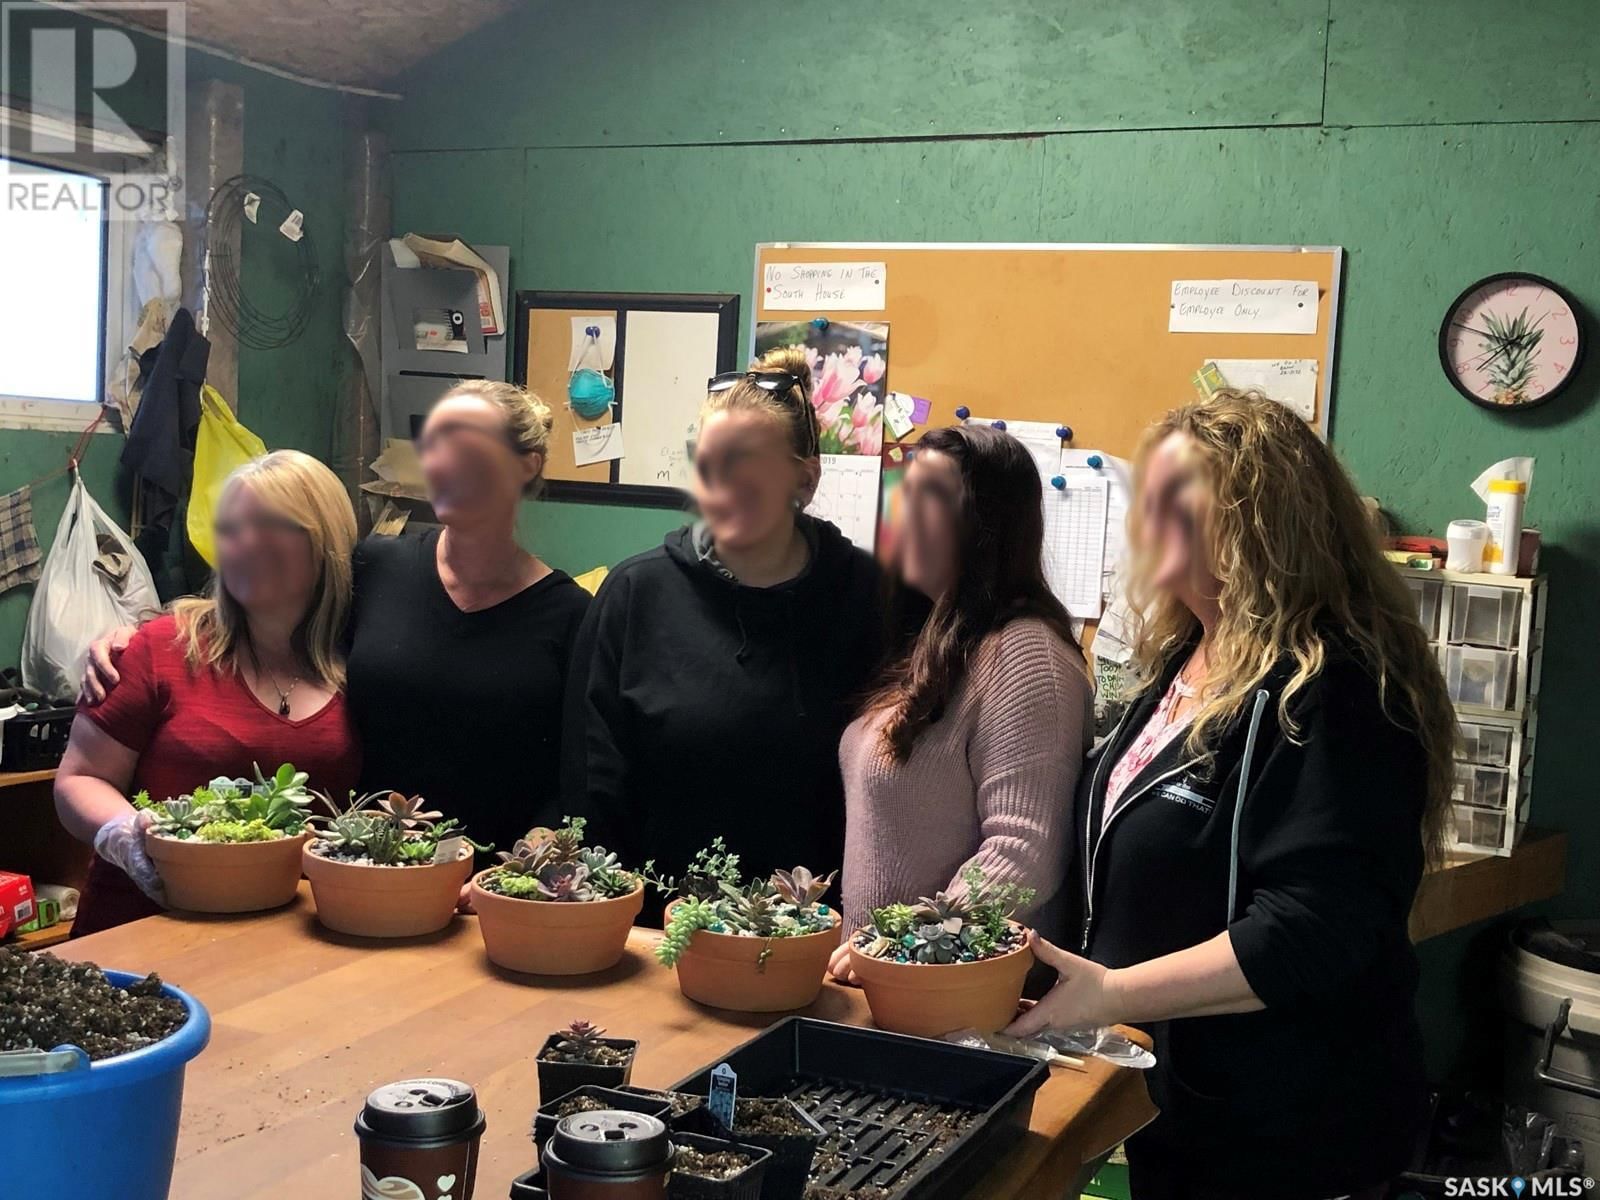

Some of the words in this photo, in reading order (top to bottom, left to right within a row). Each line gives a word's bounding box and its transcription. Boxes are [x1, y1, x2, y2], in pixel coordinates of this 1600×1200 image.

[792, 266, 832, 279] SHOPPING
[841, 269, 853, 279] IN
[859, 267, 878, 279] THE
[773, 284, 804, 300] SOUTH
[816, 282, 846, 301] HOUSE
[1174, 283, 1221, 299] EMPLOYEE
[1232, 282, 1282, 296] DISCOUNT
[1293, 284, 1309, 296] FOR
[1179, 303, 1224, 318] EMPLOYEE
[1234, 303, 1260, 319] ONLY
[821, 456, 836, 465] 019
